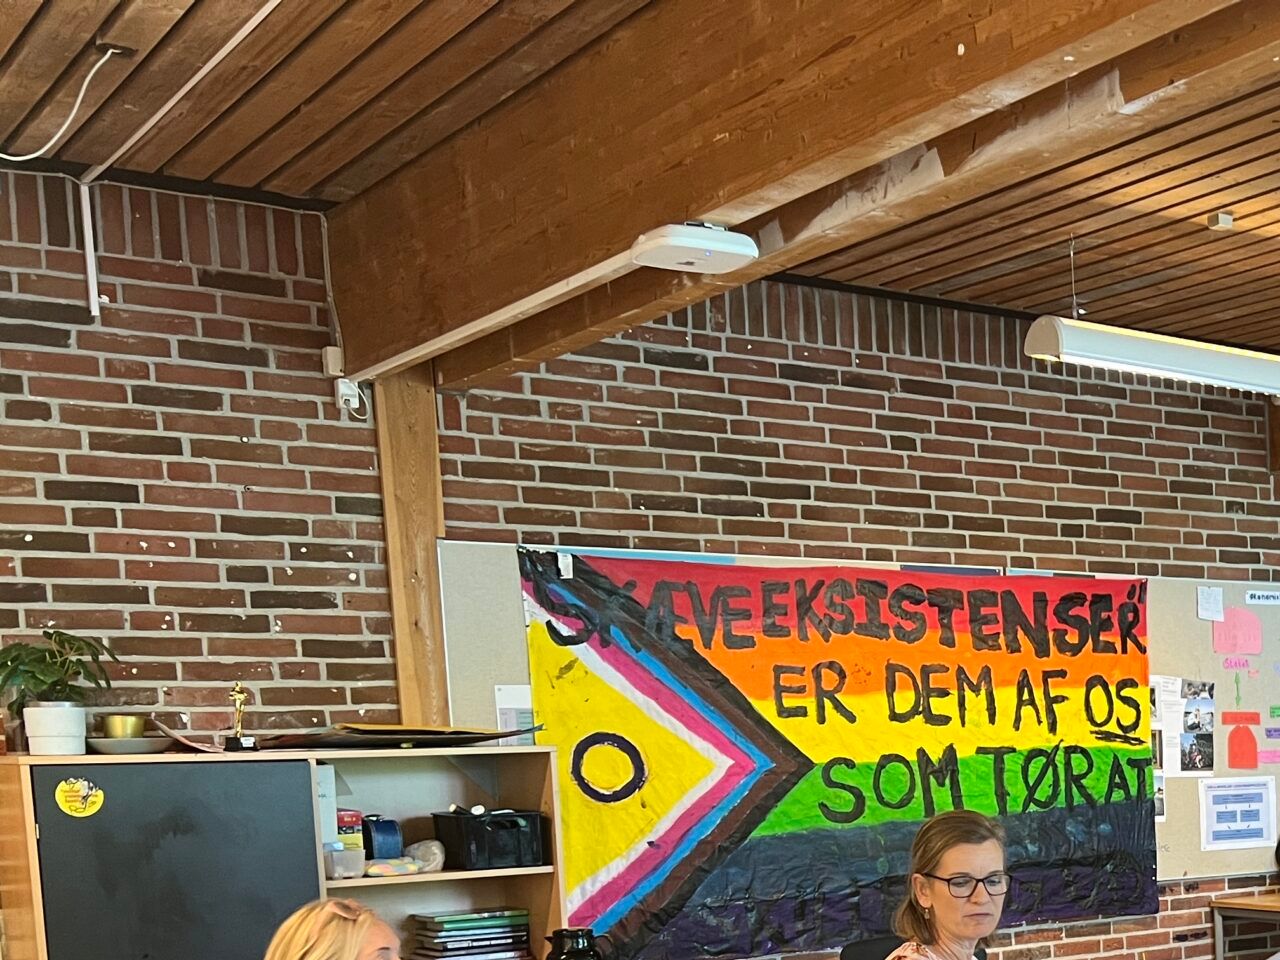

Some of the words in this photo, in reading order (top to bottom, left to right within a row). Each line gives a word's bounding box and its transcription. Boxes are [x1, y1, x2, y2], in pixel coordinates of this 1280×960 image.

[772, 658, 858, 726] ER
[884, 656, 997, 730] DEM
[1013, 667, 1070, 739] AF
[1083, 675, 1142, 736] OS
[817, 741, 959, 824] SOM
[992, 737, 1098, 818] TØR
[1104, 751, 1153, 807] AT
